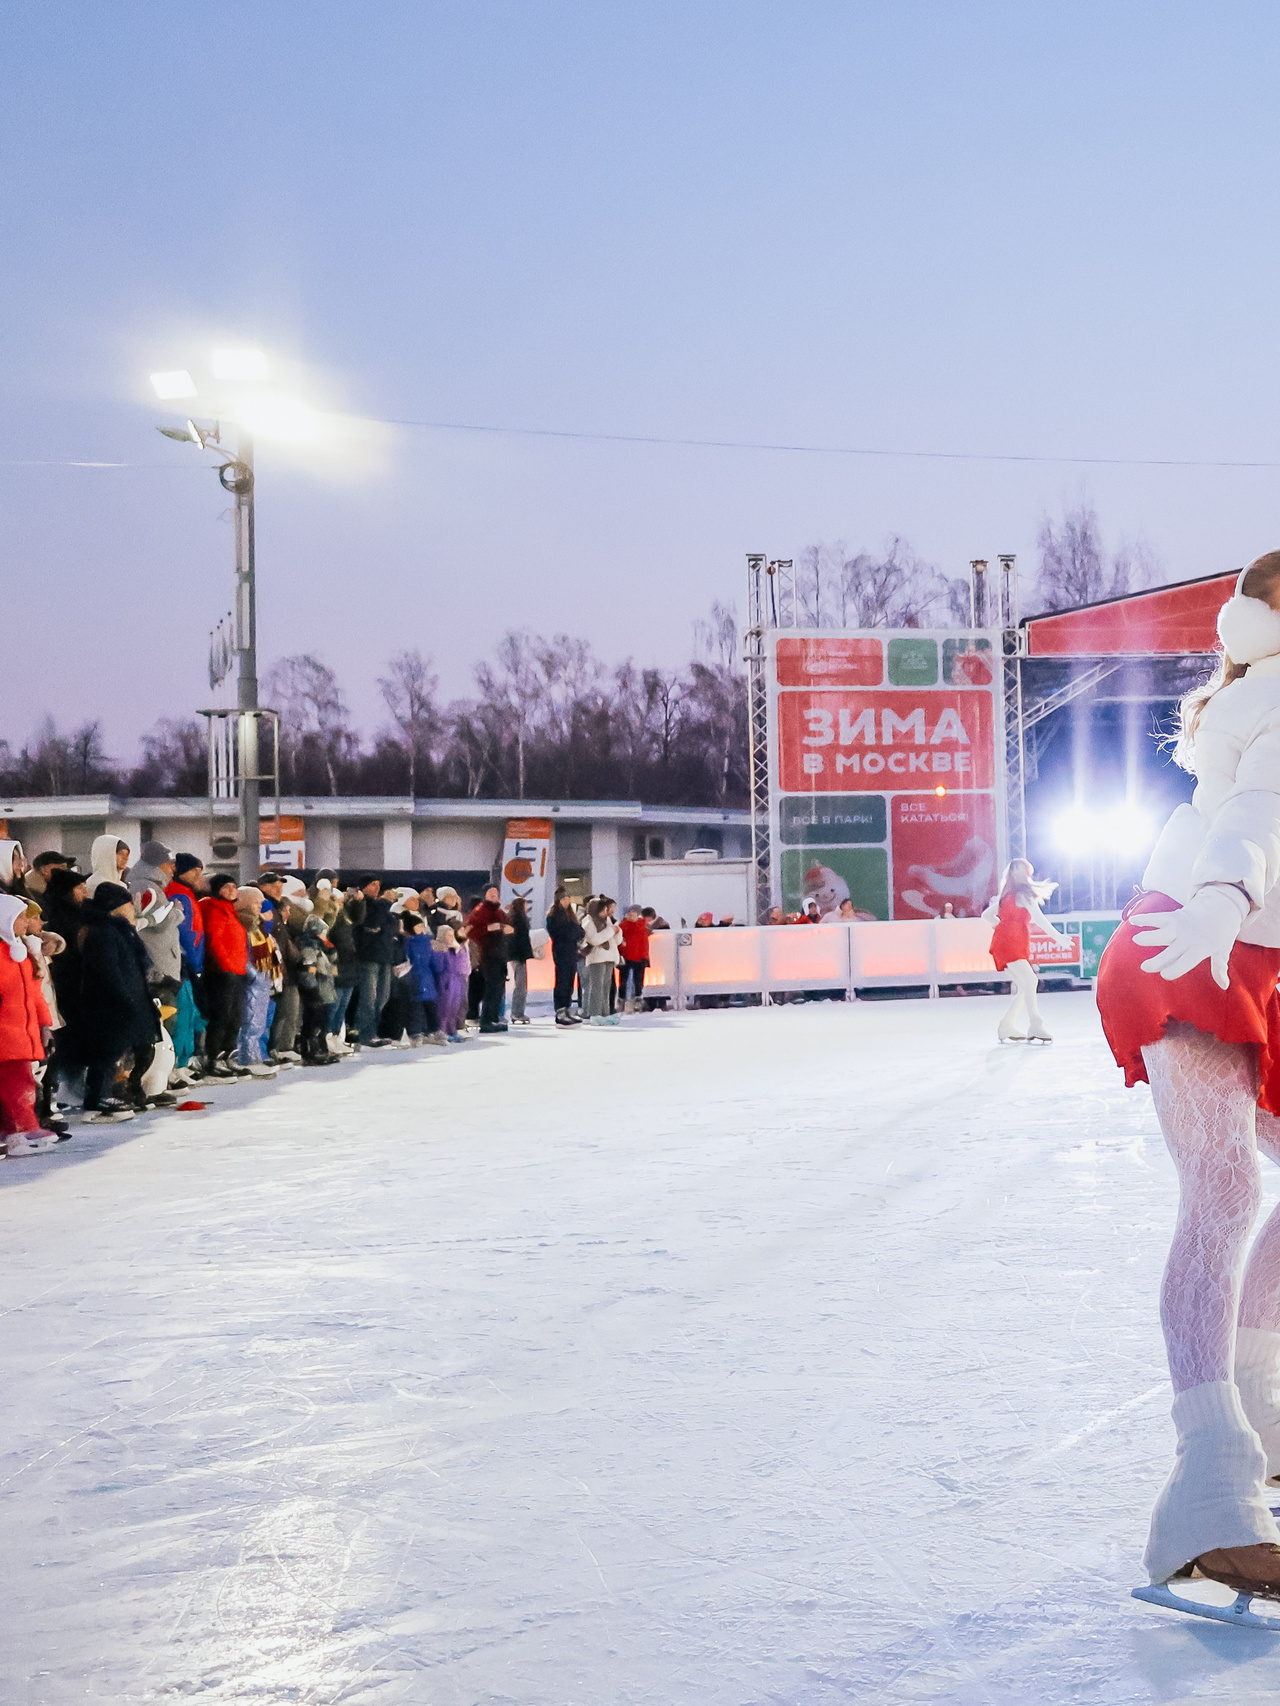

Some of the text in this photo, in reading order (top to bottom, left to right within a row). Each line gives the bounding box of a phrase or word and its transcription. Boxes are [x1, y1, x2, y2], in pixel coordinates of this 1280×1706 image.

[803, 707, 970, 747] ЗИМА
[803, 751, 971, 774] В МОСКВЕ
